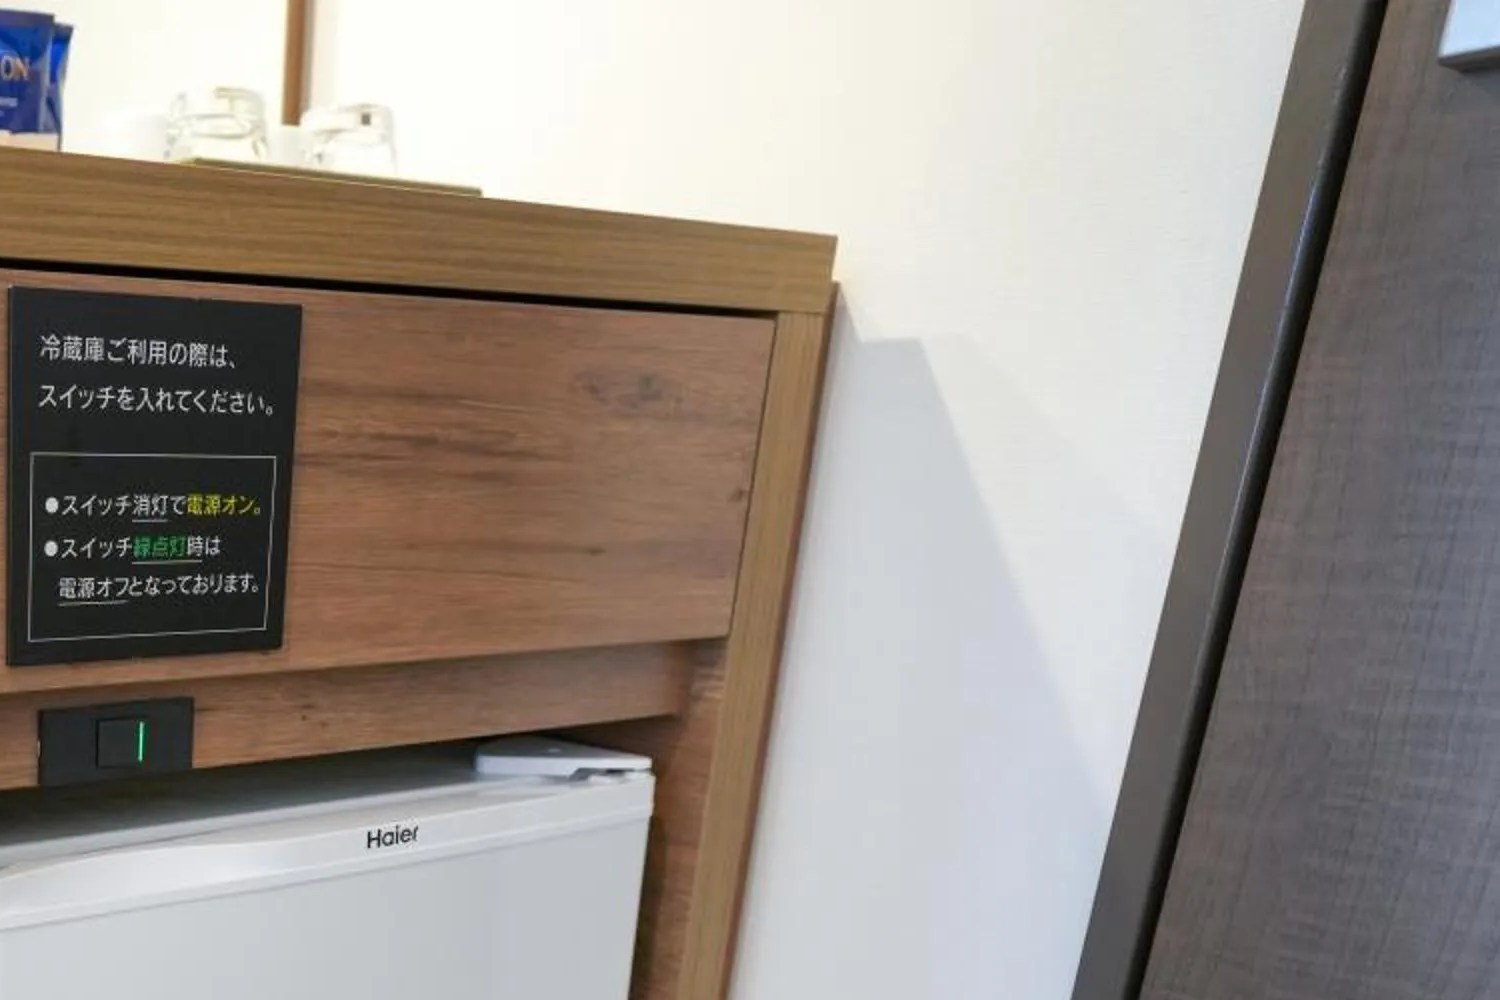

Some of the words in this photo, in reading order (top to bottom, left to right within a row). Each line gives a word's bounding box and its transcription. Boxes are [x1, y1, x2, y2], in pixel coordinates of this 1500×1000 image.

[2, 55, 31, 81] ON
[40, 333, 236, 369] 冷蔵庫ご利用の際は、
[38, 384, 274, 416] スイッチを入れてください。
[58, 573, 260, 600] 電源オフとなっております。
[366, 825, 420, 849] Haier
